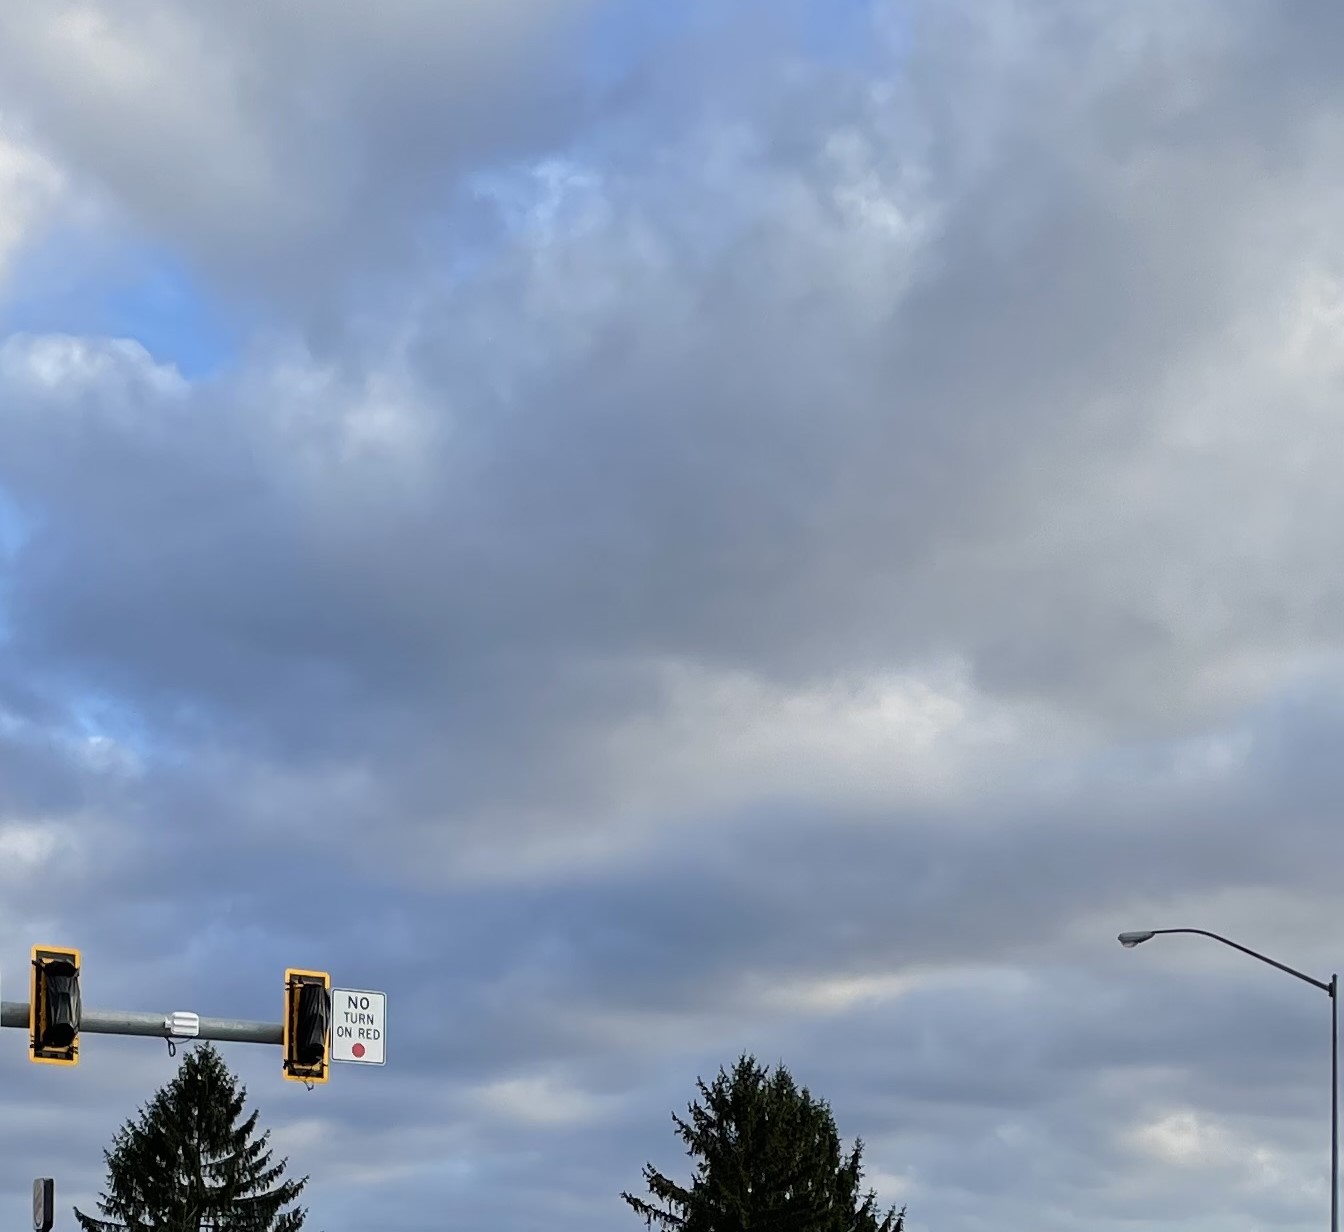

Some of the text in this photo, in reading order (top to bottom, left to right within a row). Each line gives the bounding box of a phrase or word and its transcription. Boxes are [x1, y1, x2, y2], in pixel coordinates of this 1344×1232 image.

[348, 995, 370, 1010] NO
[344, 1011, 374, 1025] TURN
[336, 1025, 381, 1040] ON RED
